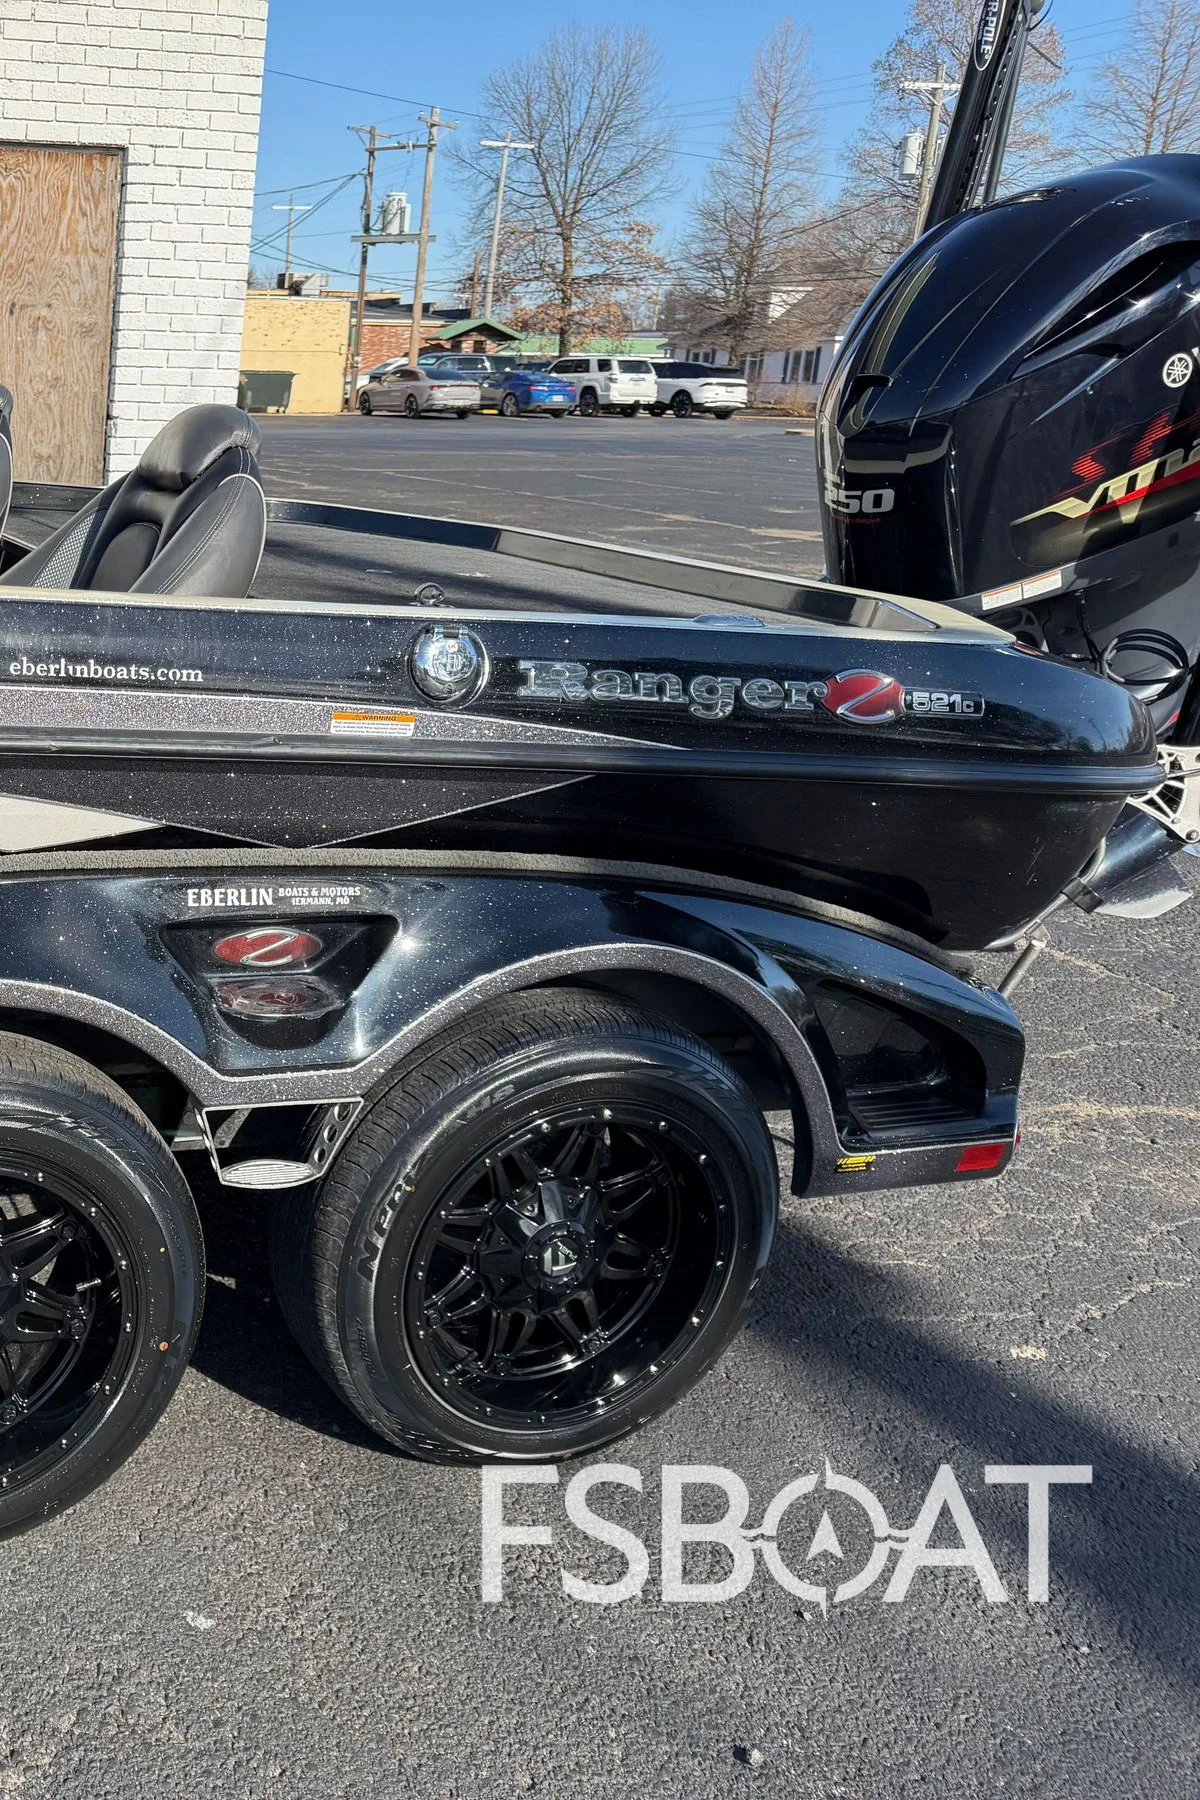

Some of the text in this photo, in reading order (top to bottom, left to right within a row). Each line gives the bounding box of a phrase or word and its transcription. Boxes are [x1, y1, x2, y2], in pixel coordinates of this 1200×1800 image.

[9, 657, 204, 682] eberlinboats.com
[517, 659, 829, 720] Ranger
[187, 887, 360, 907] EBERLIN BOATS & MOTORS
[557, 1241, 578, 1261] FUEL
